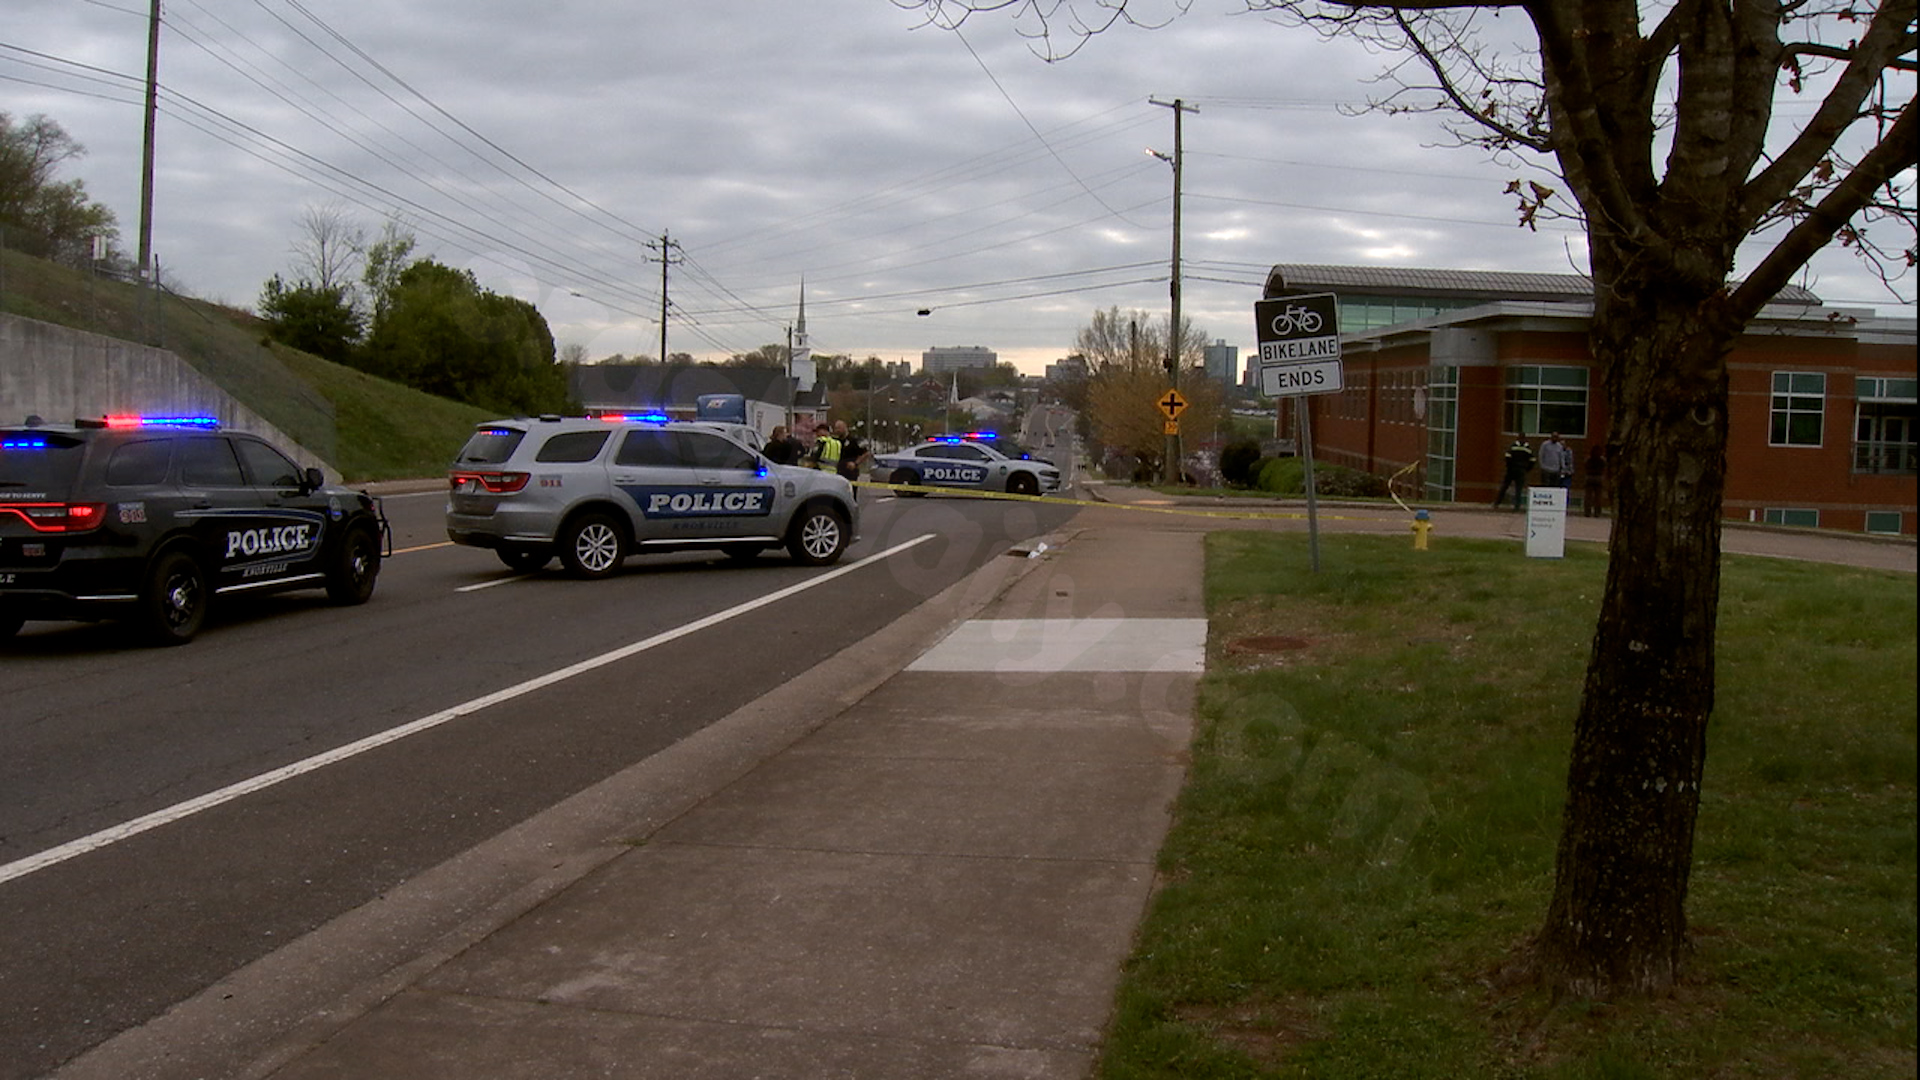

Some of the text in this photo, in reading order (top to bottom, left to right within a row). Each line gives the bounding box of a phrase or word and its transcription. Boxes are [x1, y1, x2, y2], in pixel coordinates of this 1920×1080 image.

[1264, 340, 1336, 360] BIKE LANE
[1279, 369, 1324, 388] ENDS
[925, 468, 980, 481] POLICE
[647, 492, 763, 513] POLICE
[119, 509, 147, 524] 911
[225, 524, 310, 558] POLICE
